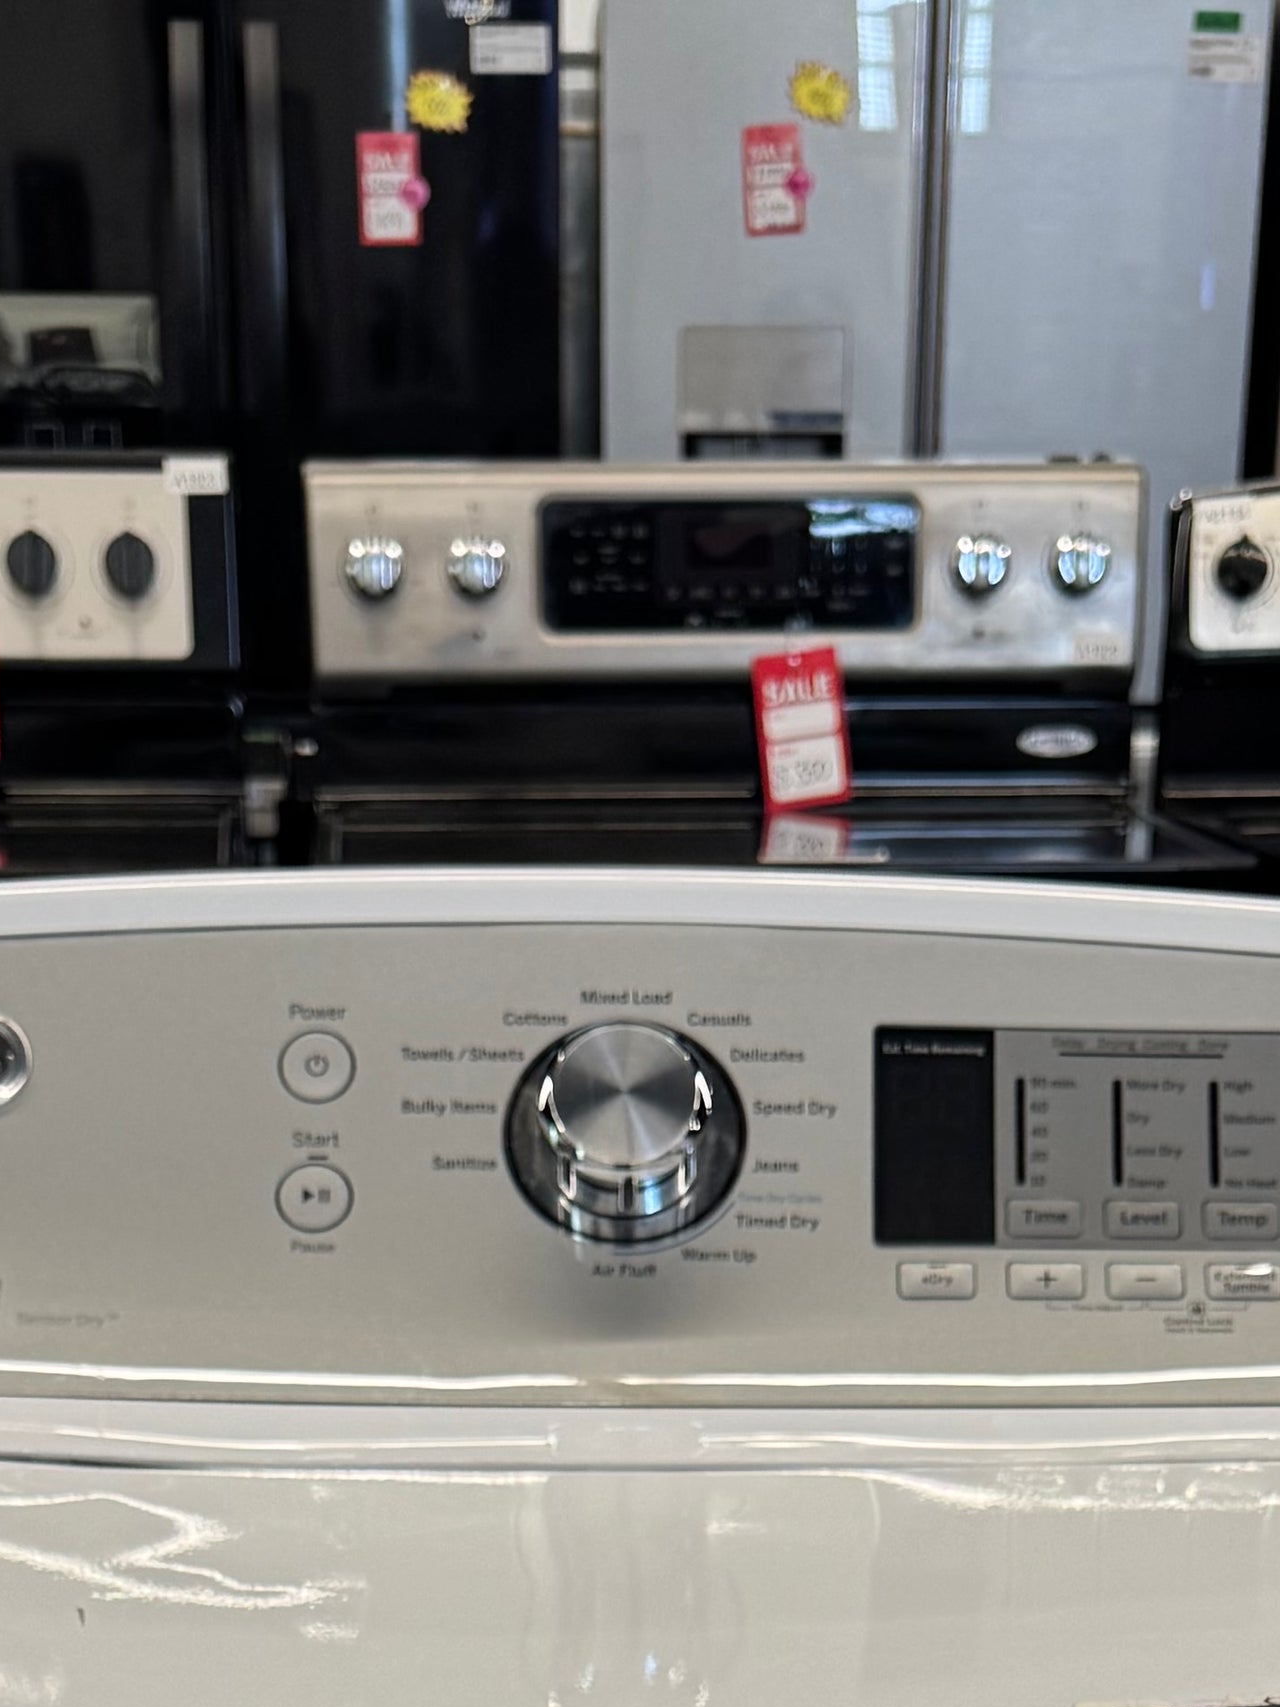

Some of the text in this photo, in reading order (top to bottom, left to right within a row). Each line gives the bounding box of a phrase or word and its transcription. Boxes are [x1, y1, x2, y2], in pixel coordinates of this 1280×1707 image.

[762, 673, 830, 706] SALE
[580, 990, 674, 1005] Mixed Load
[288, 1004, 348, 1020] Power
[503, 1012, 568, 1027] Cottons
[687, 1012, 752, 1027] Casuals
[401, 1048, 454, 1062] Towels
[469, 1048, 524, 1062] Sheets
[730, 1048, 805, 1063] Delicates
[401, 1100, 497, 1117] Bulky Items
[752, 1100, 837, 1119] Speed Dry
[291, 1131, 340, 1149] Start
[433, 1156, 498, 1171] Sanitize
[752, 1160, 800, 1173] Jeans
[735, 1214, 821, 1232] Timed Dry
[1024, 1209, 1069, 1224] Time
[1120, 1211, 1168, 1226] Level
[1219, 1211, 1269, 1228] Temp
[289, 1240, 337, 1253] Pause
[680, 1249, 758, 1266] Warm Up
[592, 1263, 658, 1278] Air Fluff
